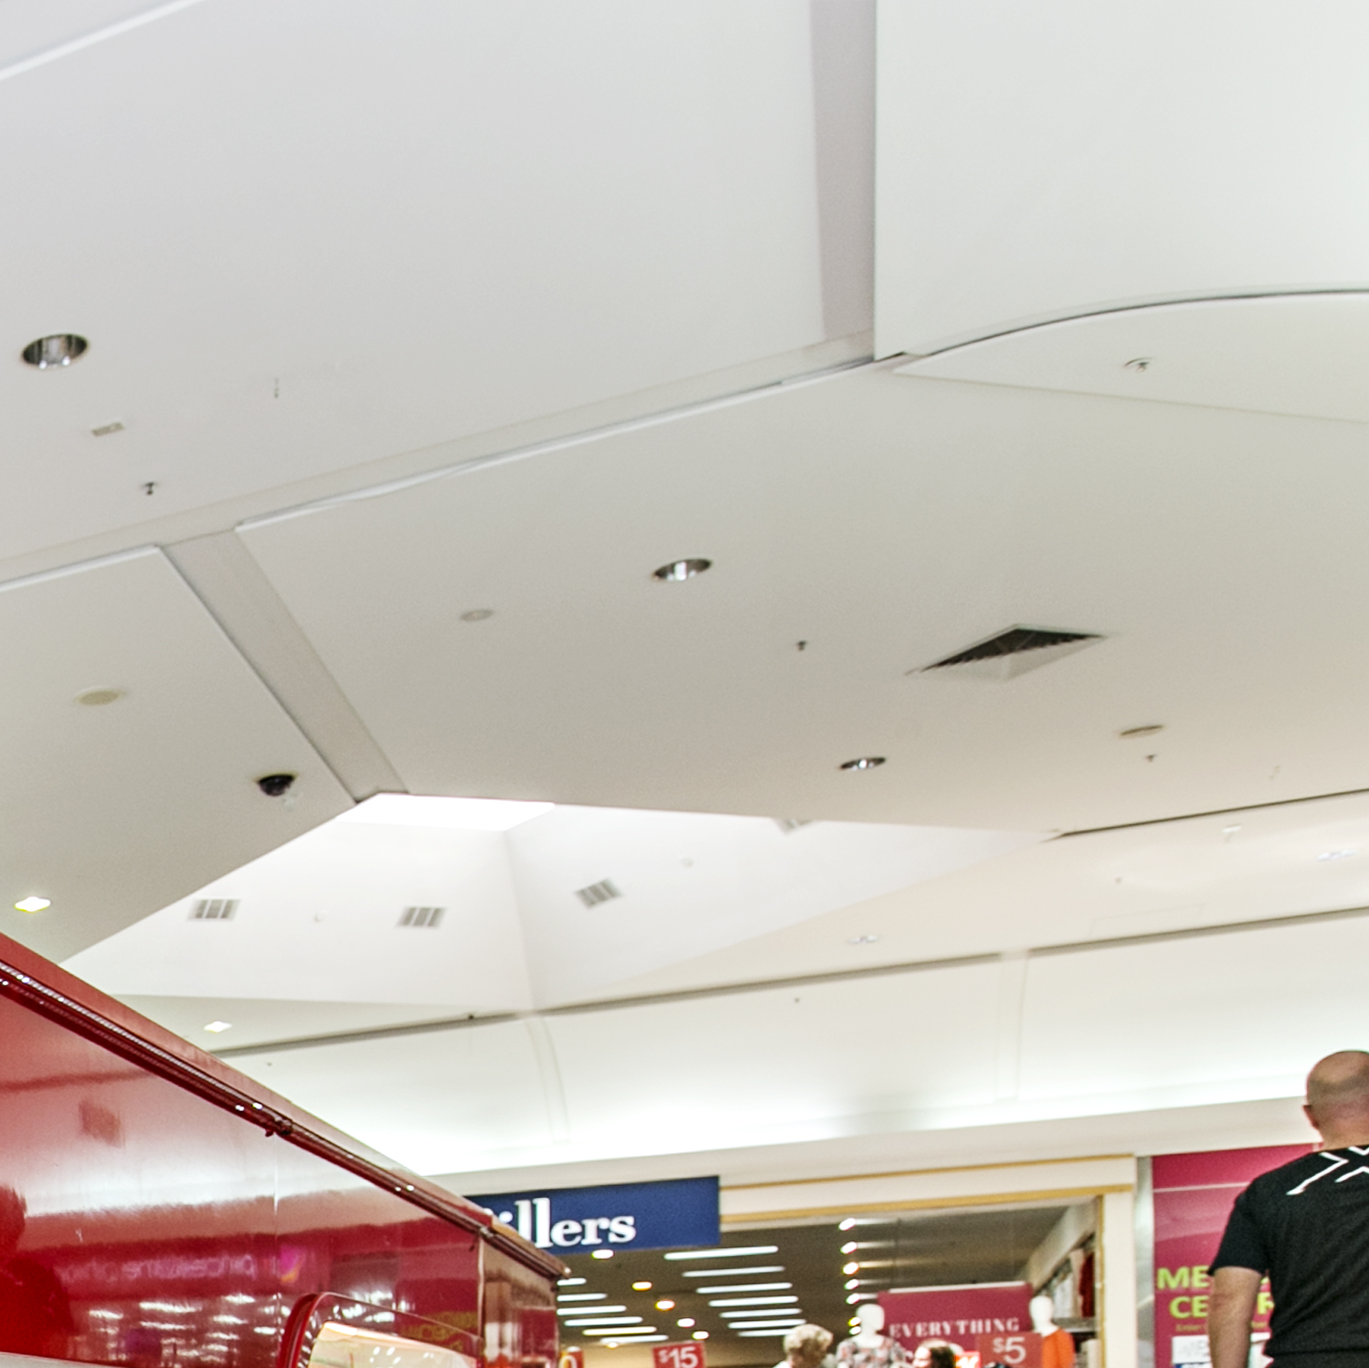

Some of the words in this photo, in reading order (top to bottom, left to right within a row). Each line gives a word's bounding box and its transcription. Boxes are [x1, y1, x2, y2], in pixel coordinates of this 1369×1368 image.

[499, 1197, 637, 1248] llers
[889, 1317, 1020, 1338] EVERYTHING
[993, 1336, 1026, 1364] $5
